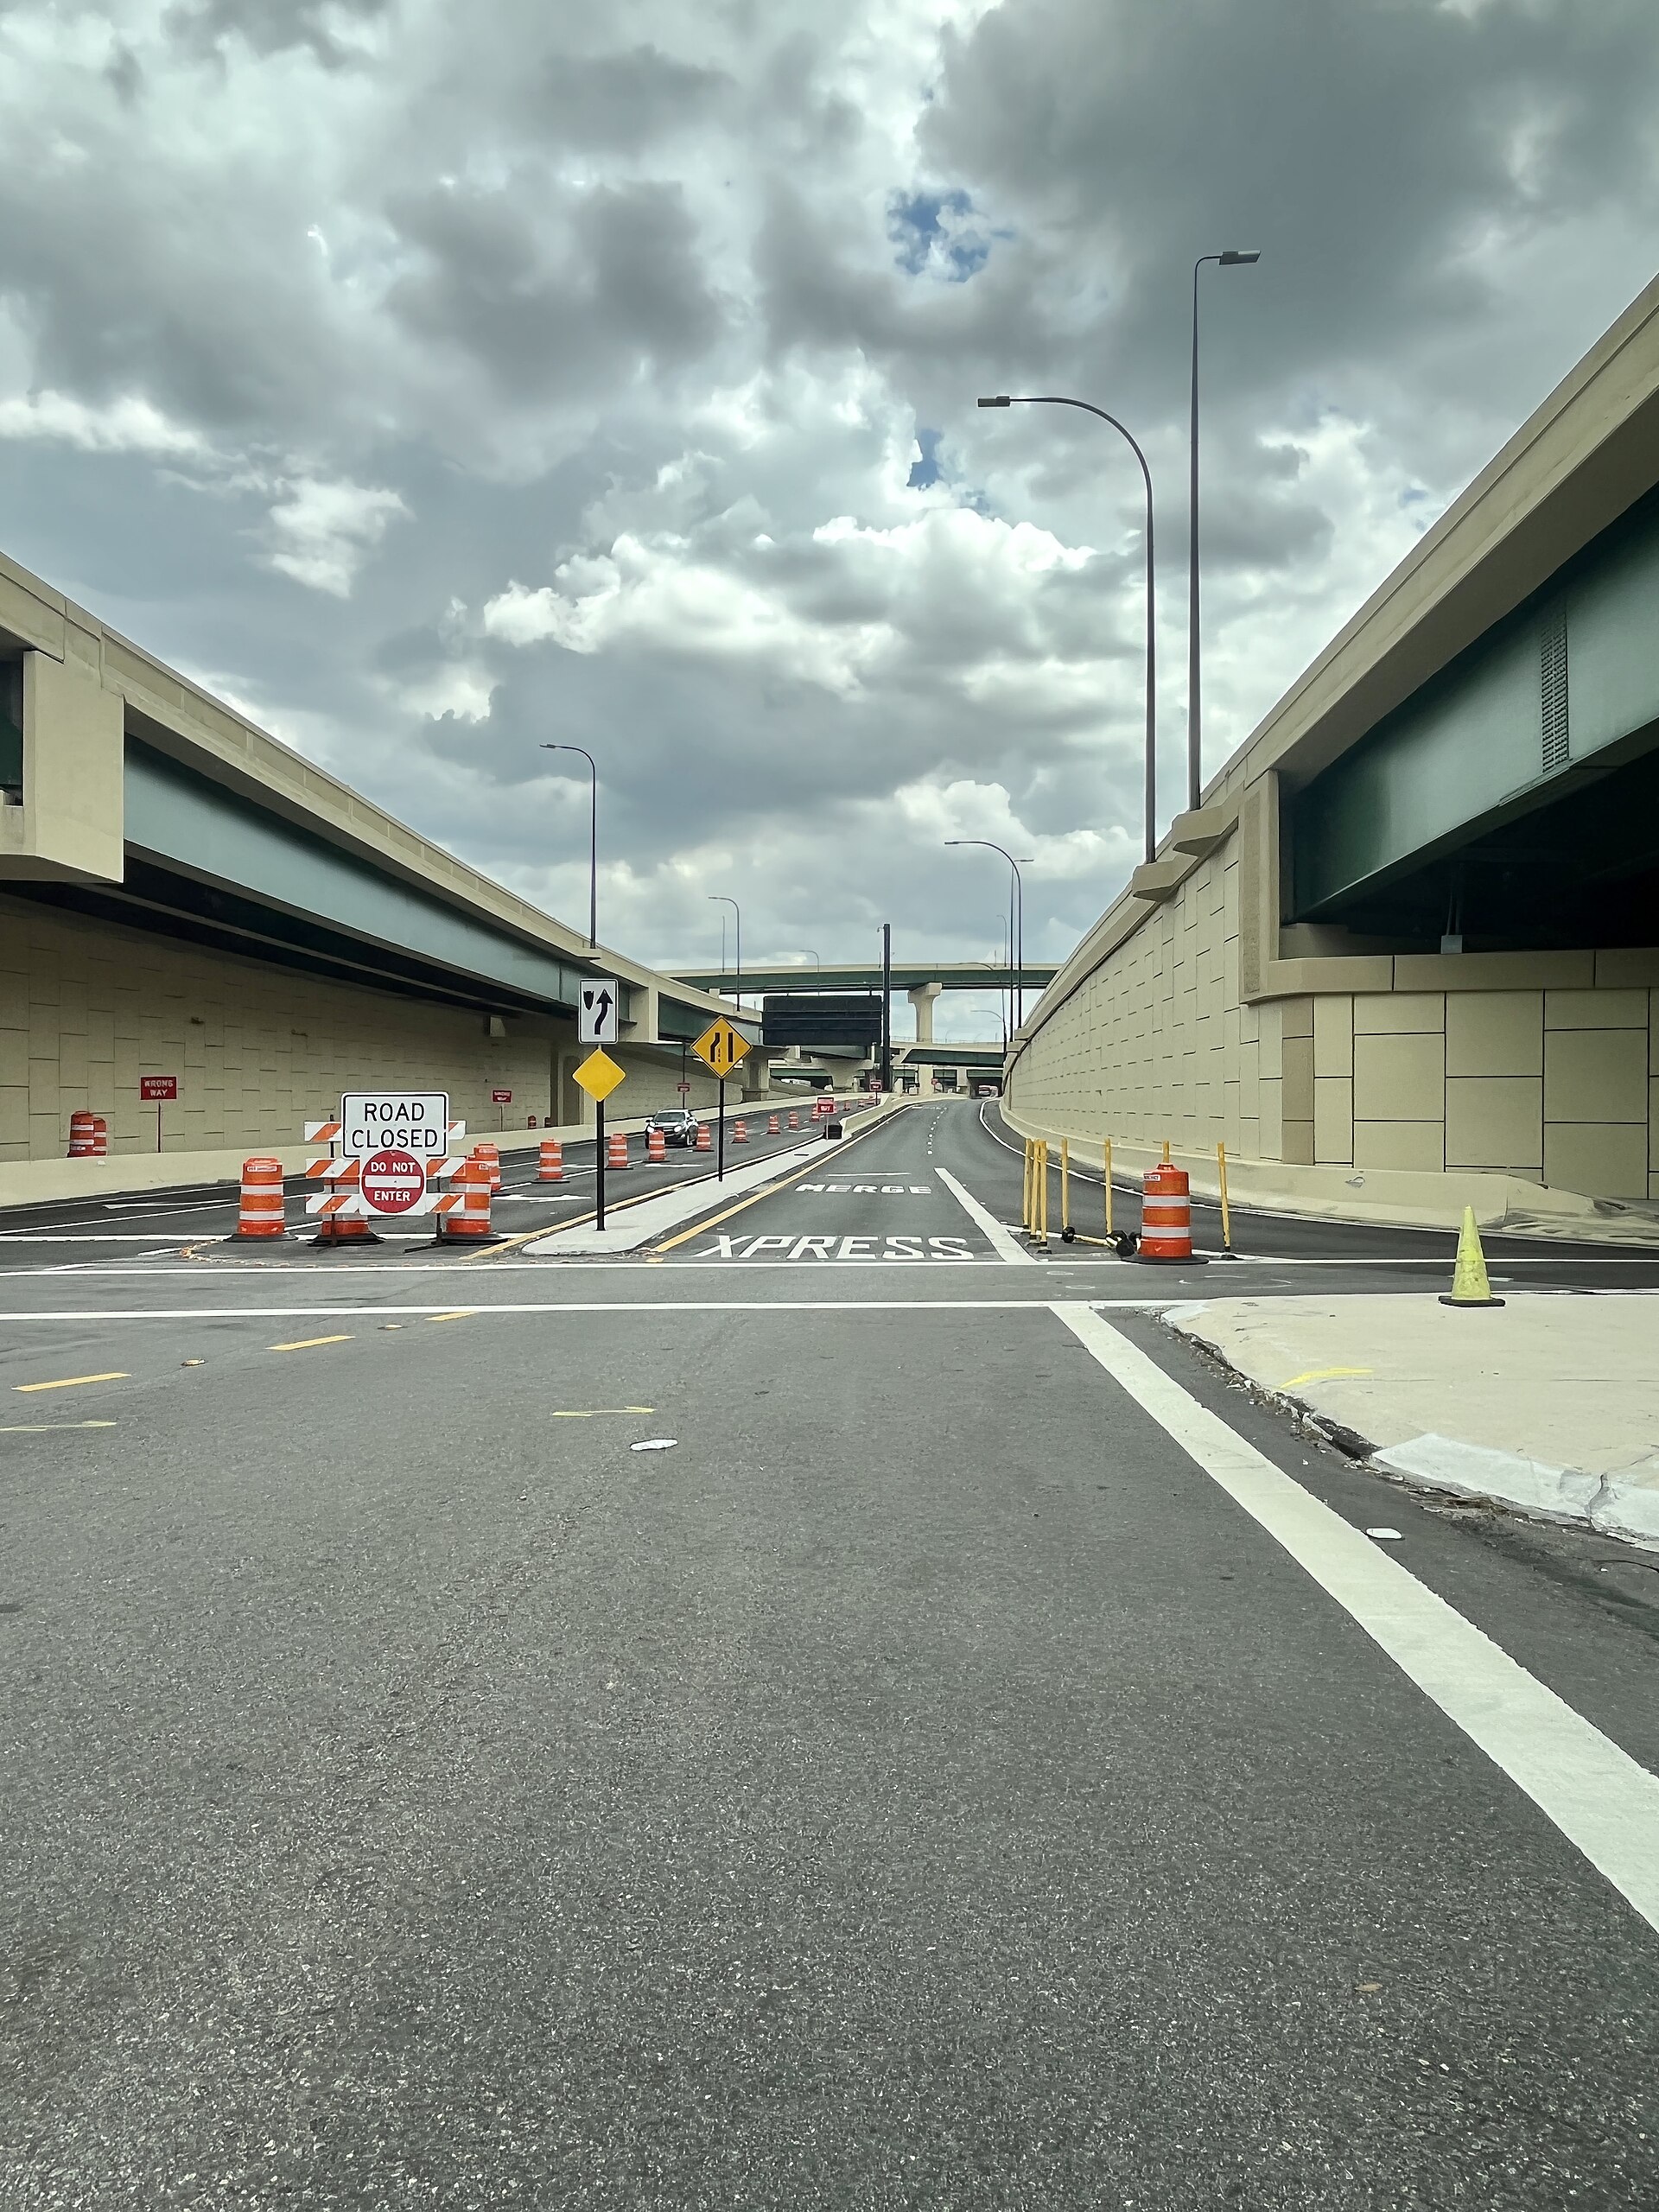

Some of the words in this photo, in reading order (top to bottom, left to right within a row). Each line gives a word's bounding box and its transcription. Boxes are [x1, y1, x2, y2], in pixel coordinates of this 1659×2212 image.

[149, 1089, 168, 1097] WAY
[364, 1103, 425, 1122] ROAD
[352, 1128, 438, 1148] CLOSED
[370, 1161, 387, 1173] DO
[392, 1161, 416, 1173] NOT
[794, 1184, 932, 1194] MERGE
[373, 1190, 411, 1202] ENTER
[691, 1235, 975, 1260] XPRESS
